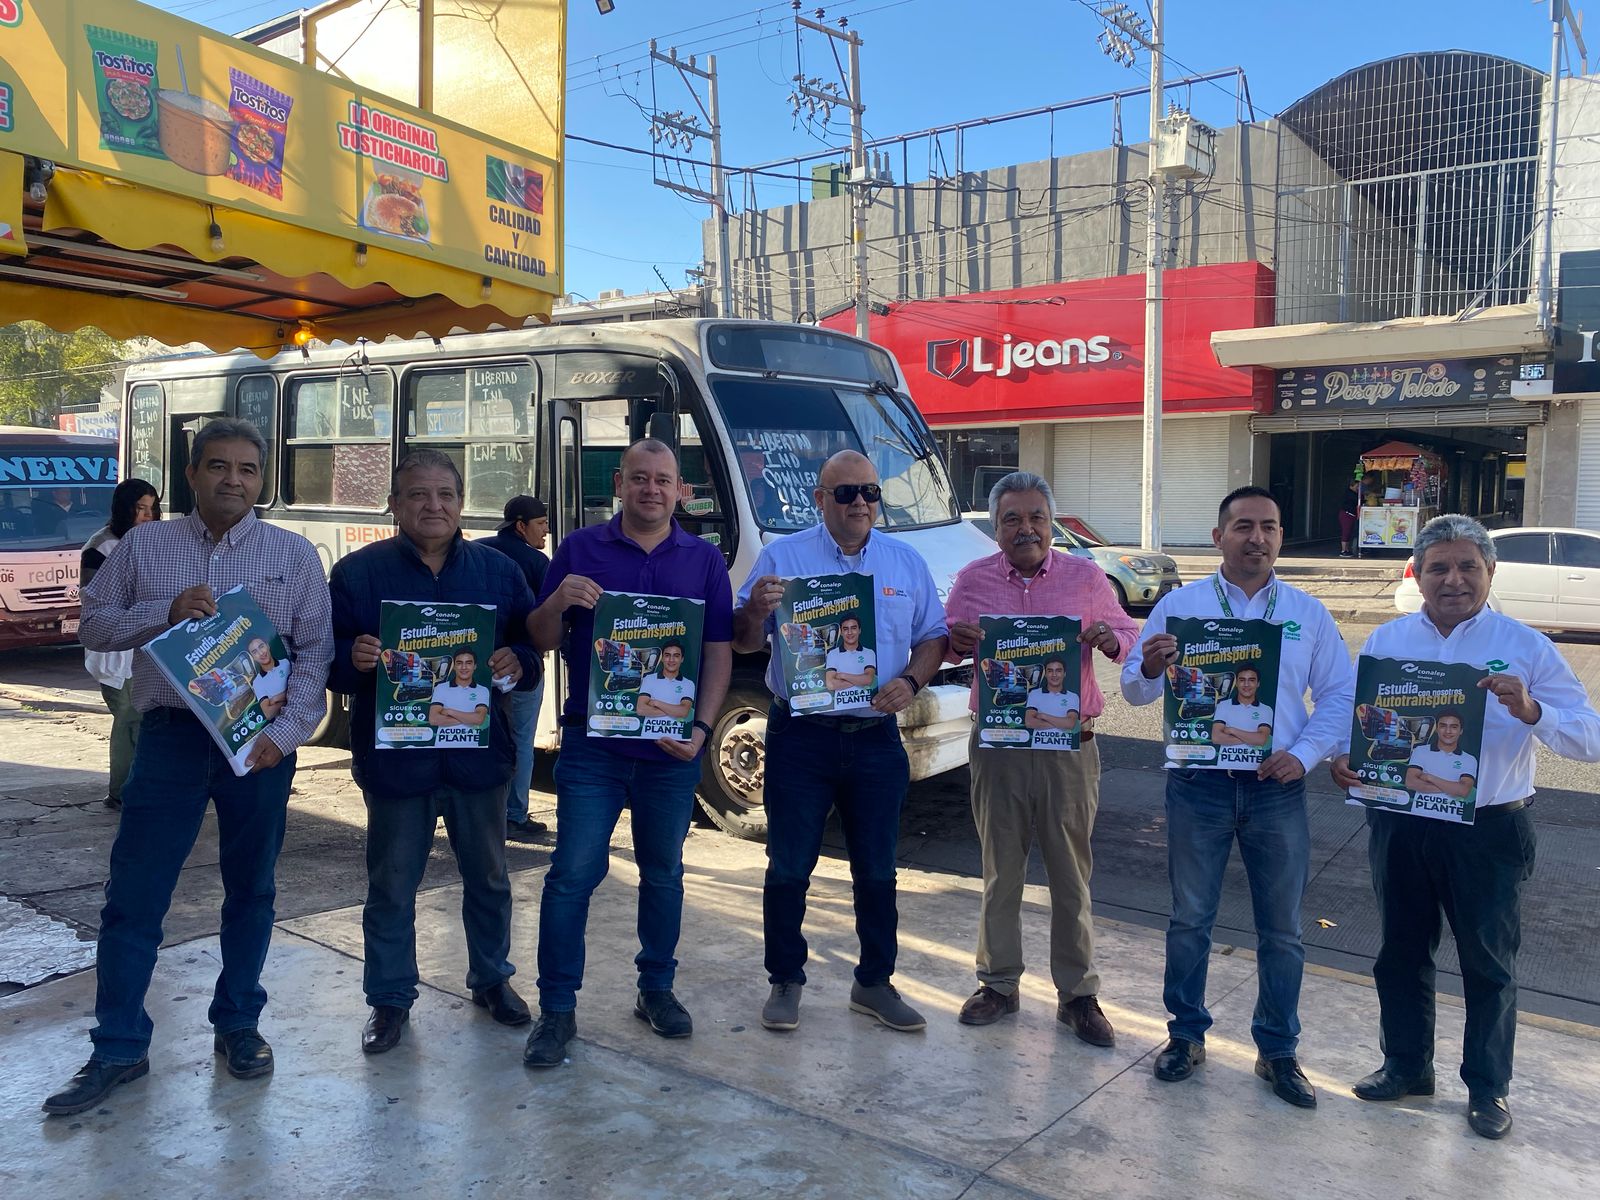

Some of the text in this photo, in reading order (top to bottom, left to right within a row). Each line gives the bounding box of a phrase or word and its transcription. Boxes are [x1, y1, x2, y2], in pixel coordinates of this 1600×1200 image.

[351, 103, 437, 151] LA ORIGINAL
[339, 125, 447, 179] TOSTICHAROLA
[489, 204, 541, 236] CALIDAD
[511, 231, 520, 249] Y
[484, 244, 546, 277] CANTIDAD
[1577, 330, 1600, 363] I
[475, 371, 517, 386] LIBERTAD
[570, 371, 636, 385] BOXER
[1323, 368, 1461, 406] Pasaje Toledo
[747, 432, 812, 451] LIBERTAD
[473, 445, 497, 461] INE
[0, 573, 14, 583] 06
[28, 564, 79, 585] redplu
[792, 598, 859, 623] Autotransporte
[793, 596, 823, 612] Estudia
[823, 600, 833, 608] con
[614, 616, 648, 629] Estudia
[1218, 626, 1244, 634] conalep
[400, 625, 437, 640] Estudia
[610, 626, 686, 641] Autotransporte
[185, 636, 217, 665] Estudia
[216, 633, 226, 644] con
[192, 616, 253, 676] Autotransporte
[398, 632, 478, 650] Autotransporte
[997, 636, 1028, 650] Estudia
[1184, 640, 1220, 655] Estudia
[995, 642, 1066, 660] Autotransporte
[1182, 648, 1262, 667] Autotransporte
[1418, 669, 1445, 677] conalep
[837, 690, 858, 698] ACUDE
[1378, 682, 1418, 696] Estudia
[1374, 694, 1465, 708] Autotransporte
[1417, 795, 1448, 804] ACUDE
